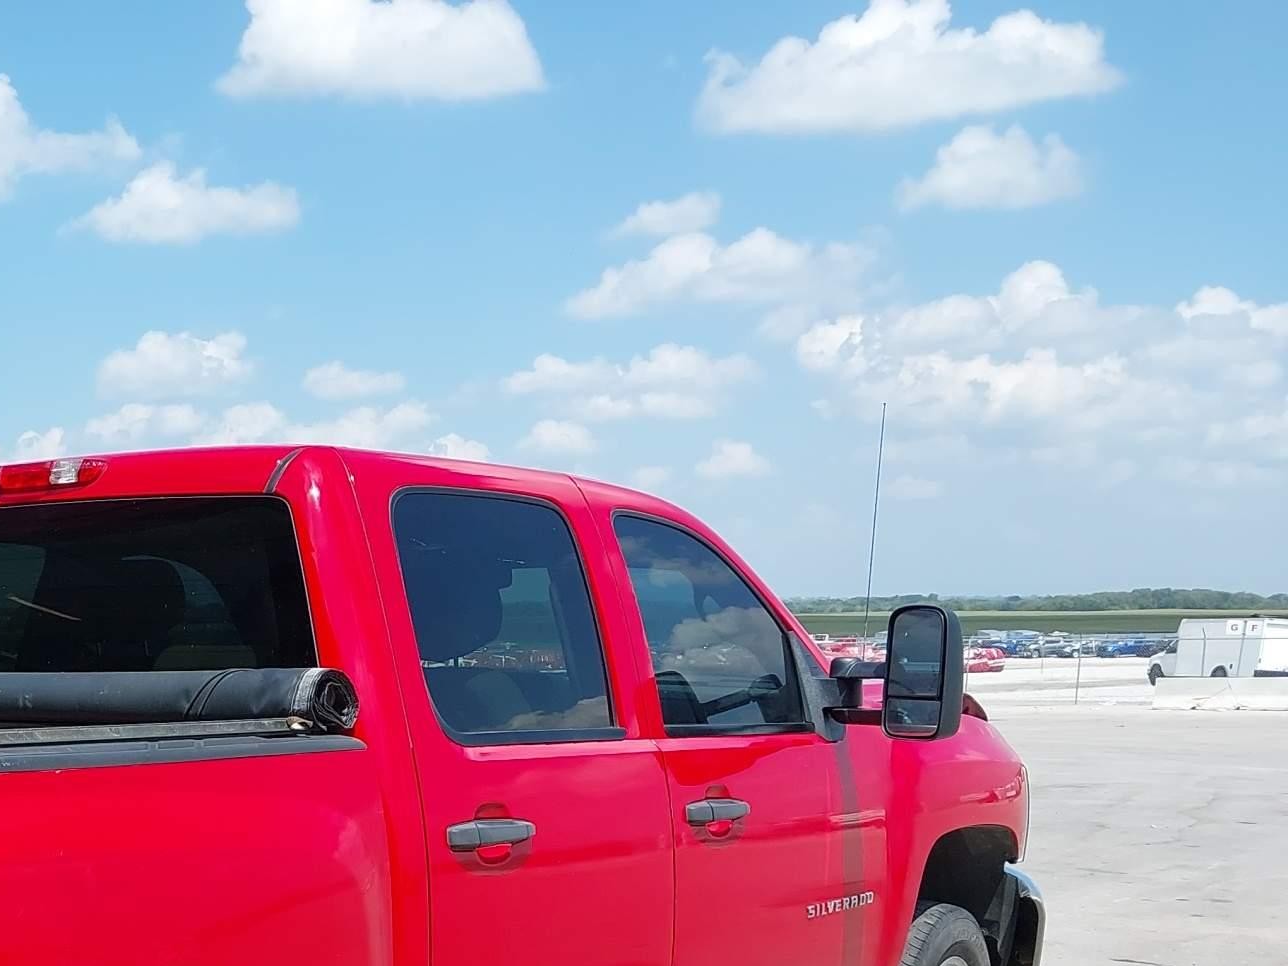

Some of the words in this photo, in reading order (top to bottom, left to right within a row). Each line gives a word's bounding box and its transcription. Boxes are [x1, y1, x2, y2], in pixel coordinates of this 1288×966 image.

[1230, 623, 1239, 632] G
[1251, 624, 1259, 632] F
[806, 891, 874, 919] SILVERADO
